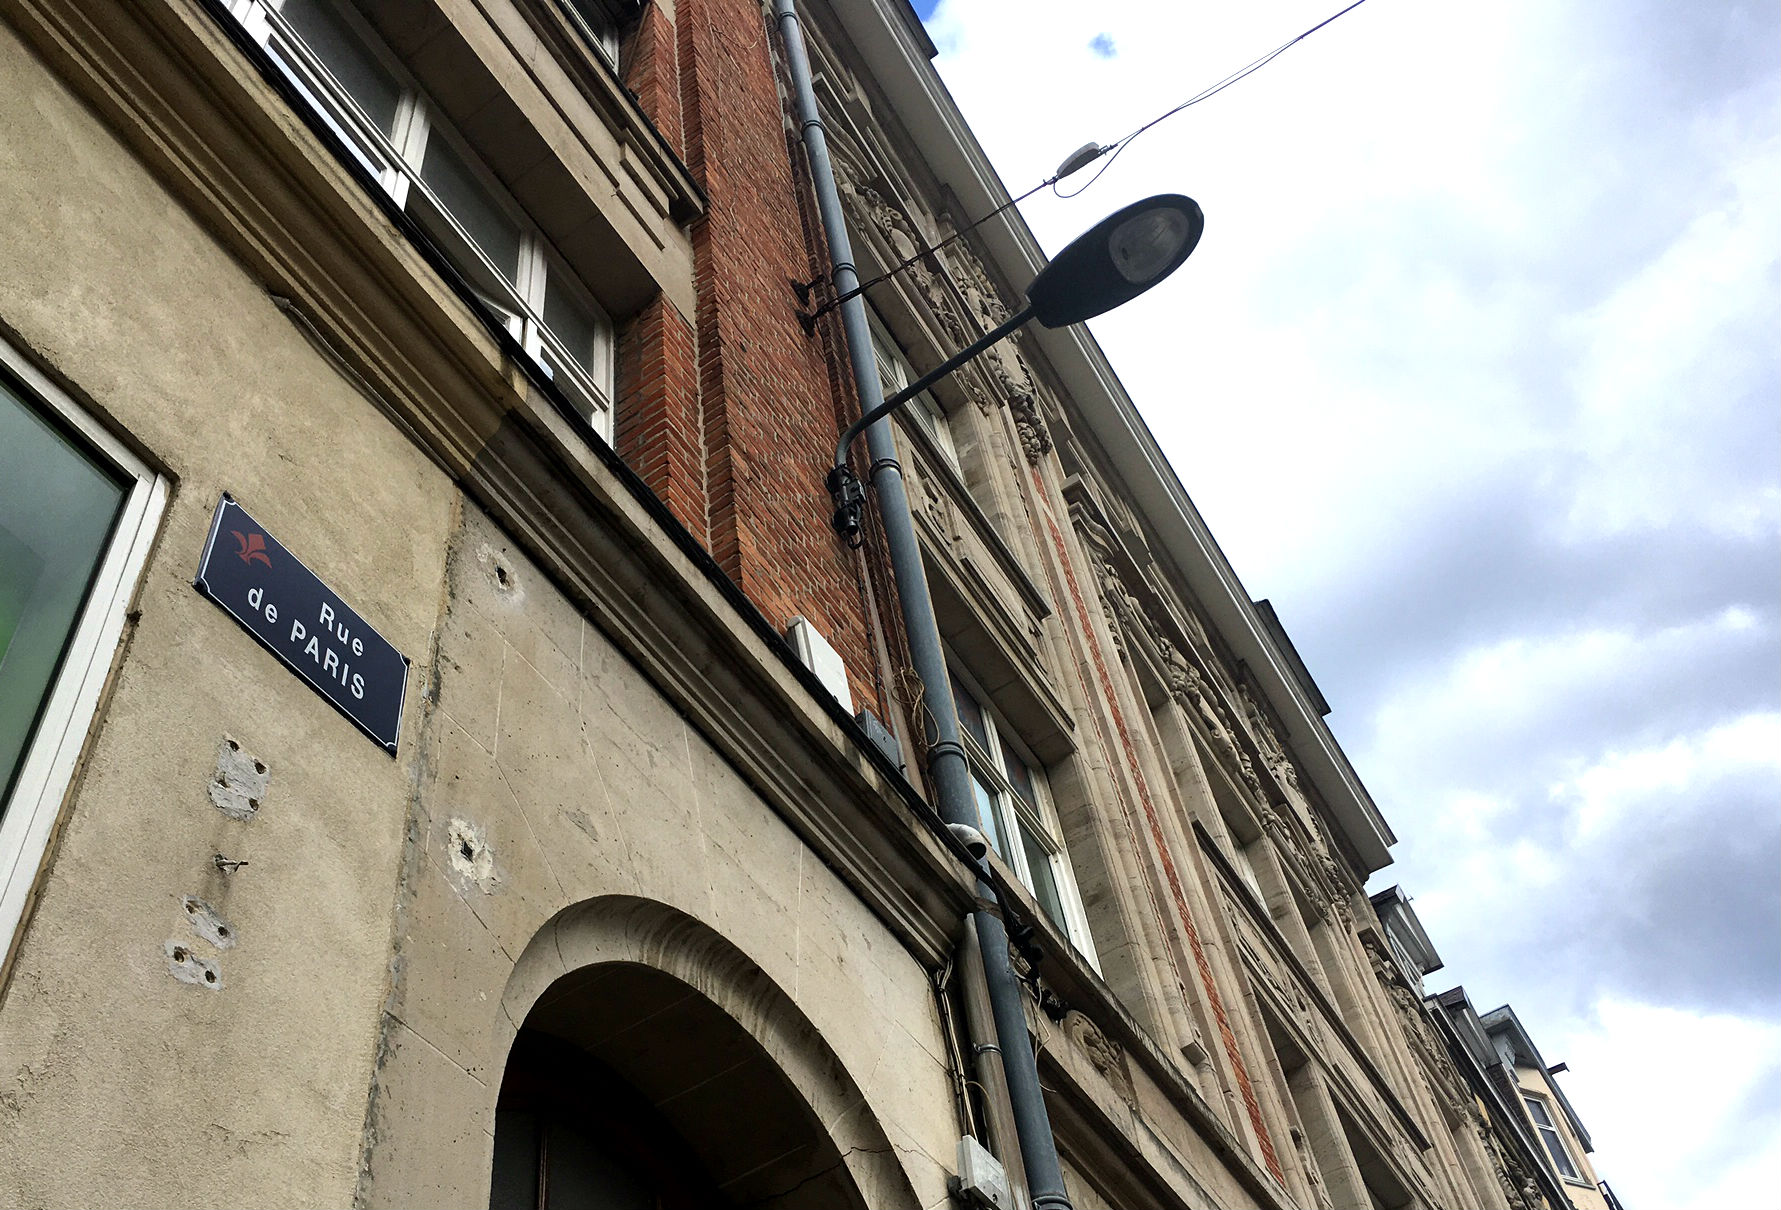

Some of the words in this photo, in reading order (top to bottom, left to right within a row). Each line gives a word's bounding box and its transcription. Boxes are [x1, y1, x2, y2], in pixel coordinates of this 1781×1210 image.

[247, 587, 278, 624] de
[290, 619, 365, 700] PARIS
[319, 602, 364, 657] Rue
